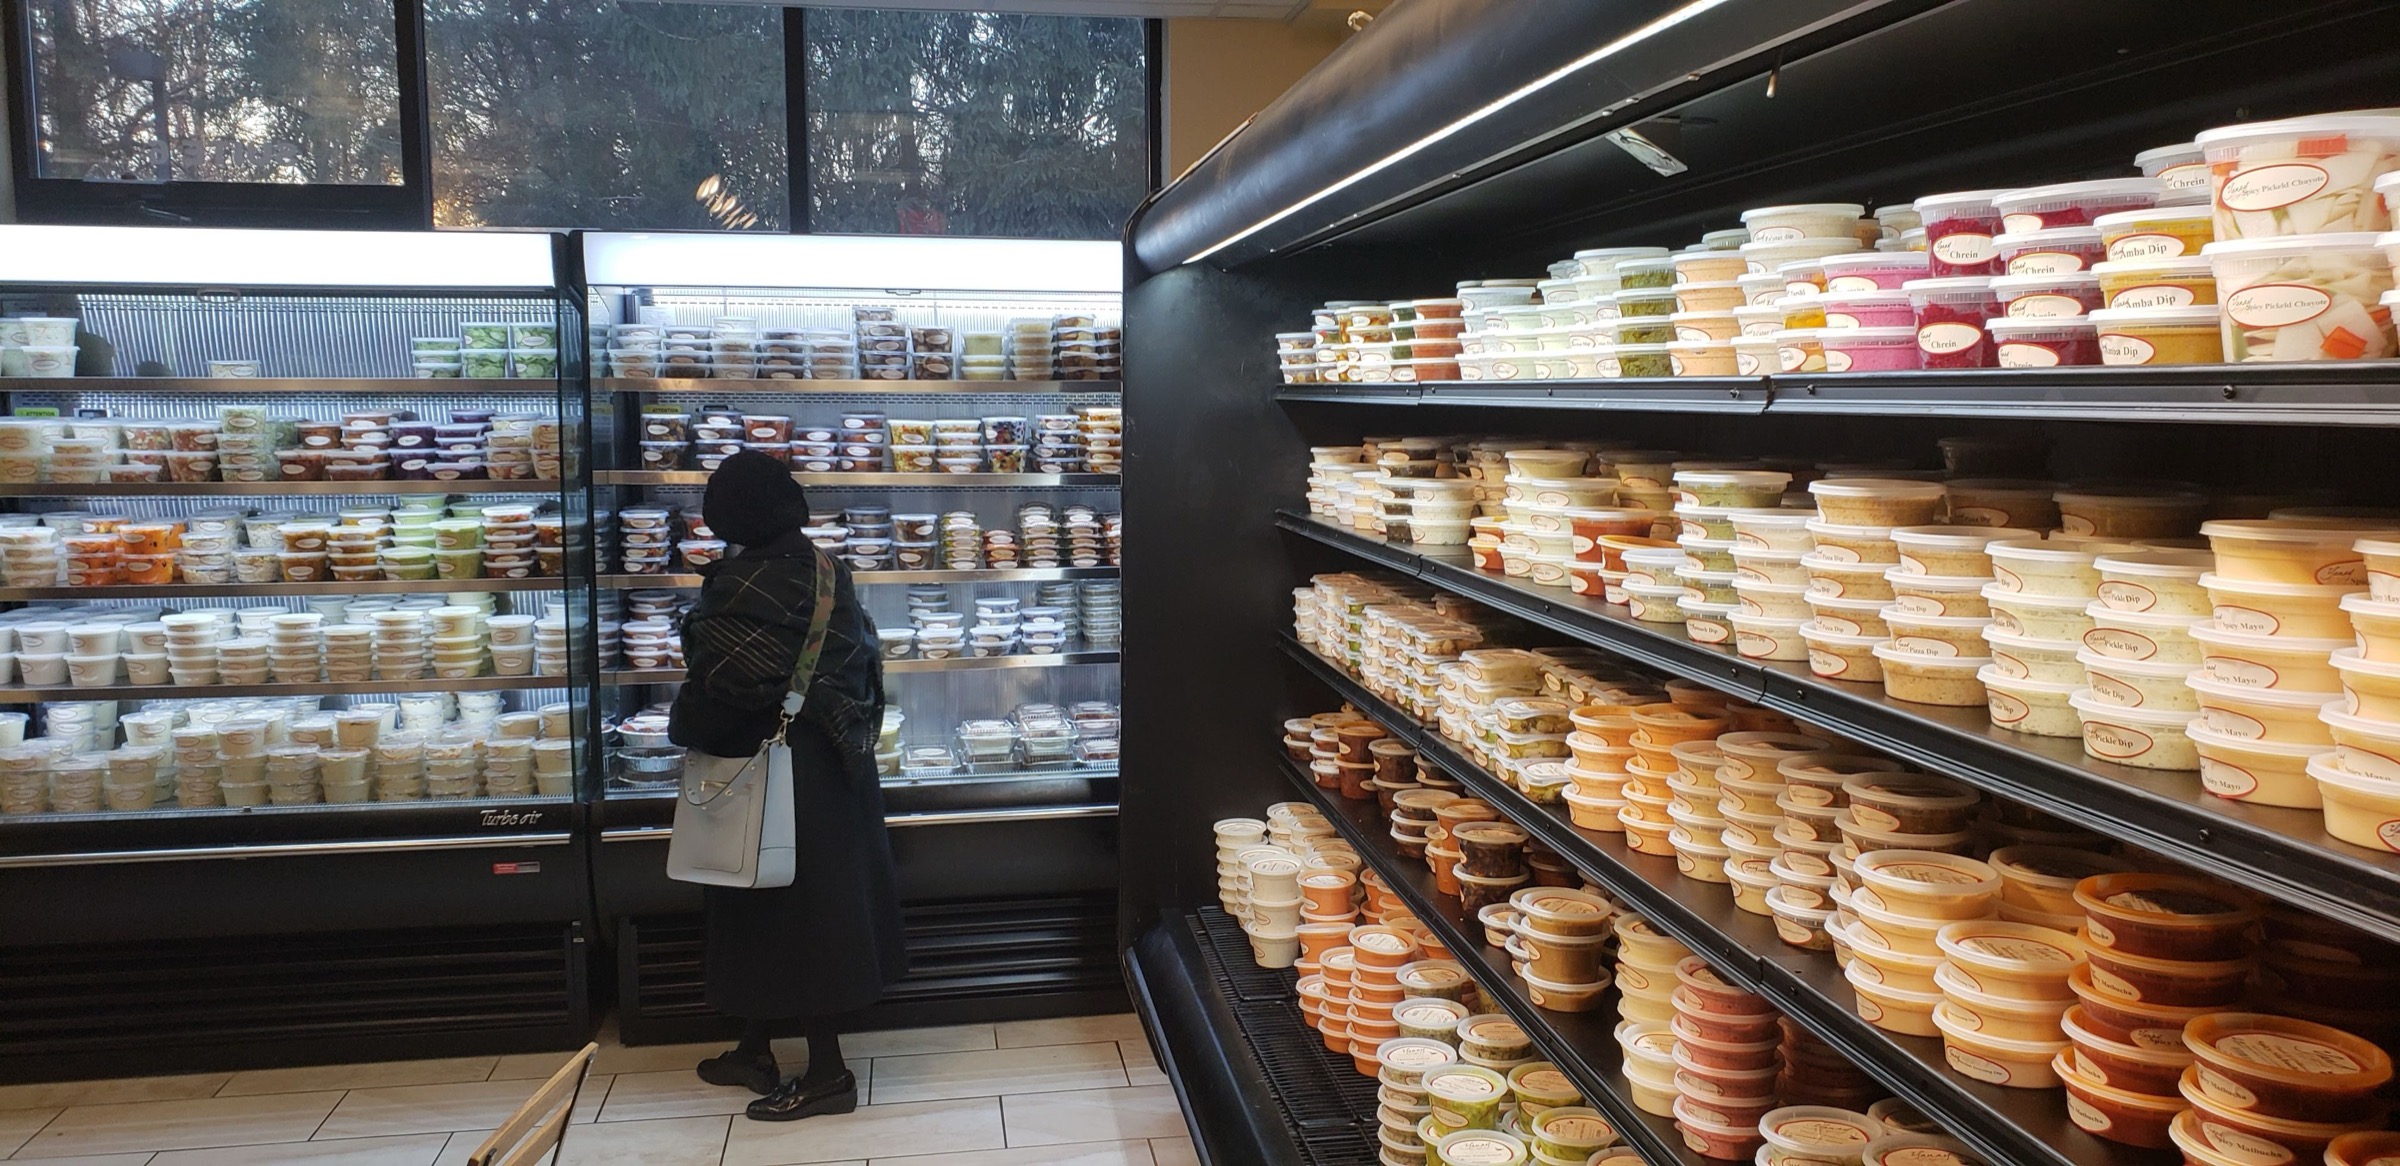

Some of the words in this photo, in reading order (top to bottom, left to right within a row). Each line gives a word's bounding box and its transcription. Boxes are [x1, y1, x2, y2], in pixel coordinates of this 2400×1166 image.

[2173, 177, 2205, 189] Chrein
[2262, 181, 2290, 194] Pickeld
[2291, 175, 2325, 188] Chayote
[1950, 250, 1978, 259] Chrein
[2120, 247, 2145, 260] Amba
[2148, 244, 2167, 255] Dip
[2025, 265, 2055, 275] Chrein
[2126, 299, 2153, 309] Amba
[2156, 295, 2176, 306] Dip
[2264, 301, 2292, 311] Pickeld
[2294, 299, 2328, 309] Chayote
[1931, 341, 1957, 349] Chrein
[2123, 347, 2138, 357] Dip
[2125, 594, 2140, 603] Dip
[2385, 595, 2400, 603] May
[2222, 622, 2239, 632] Spicy
[2241, 622, 2264, 632] Mayo
[2104, 638, 2124, 651] Pickle
[2124, 642, 2139, 653] Dip
[1926, 648, 1939, 656] Dip
[2212, 673, 2231, 684] Spicy
[2233, 676, 2257, 685] Mayo
[2092, 683, 2111, 697] Pickle
[2112, 690, 2125, 701] Dip
[2225, 727, 2248, 738] Mayo
[2095, 733, 2117, 746] Pickle
[2118, 738, 2133, 749] Dip
[2219, 780, 2241, 792] Mayo
[480, 809, 518, 827] Turbo
[519, 809, 543, 826] air
